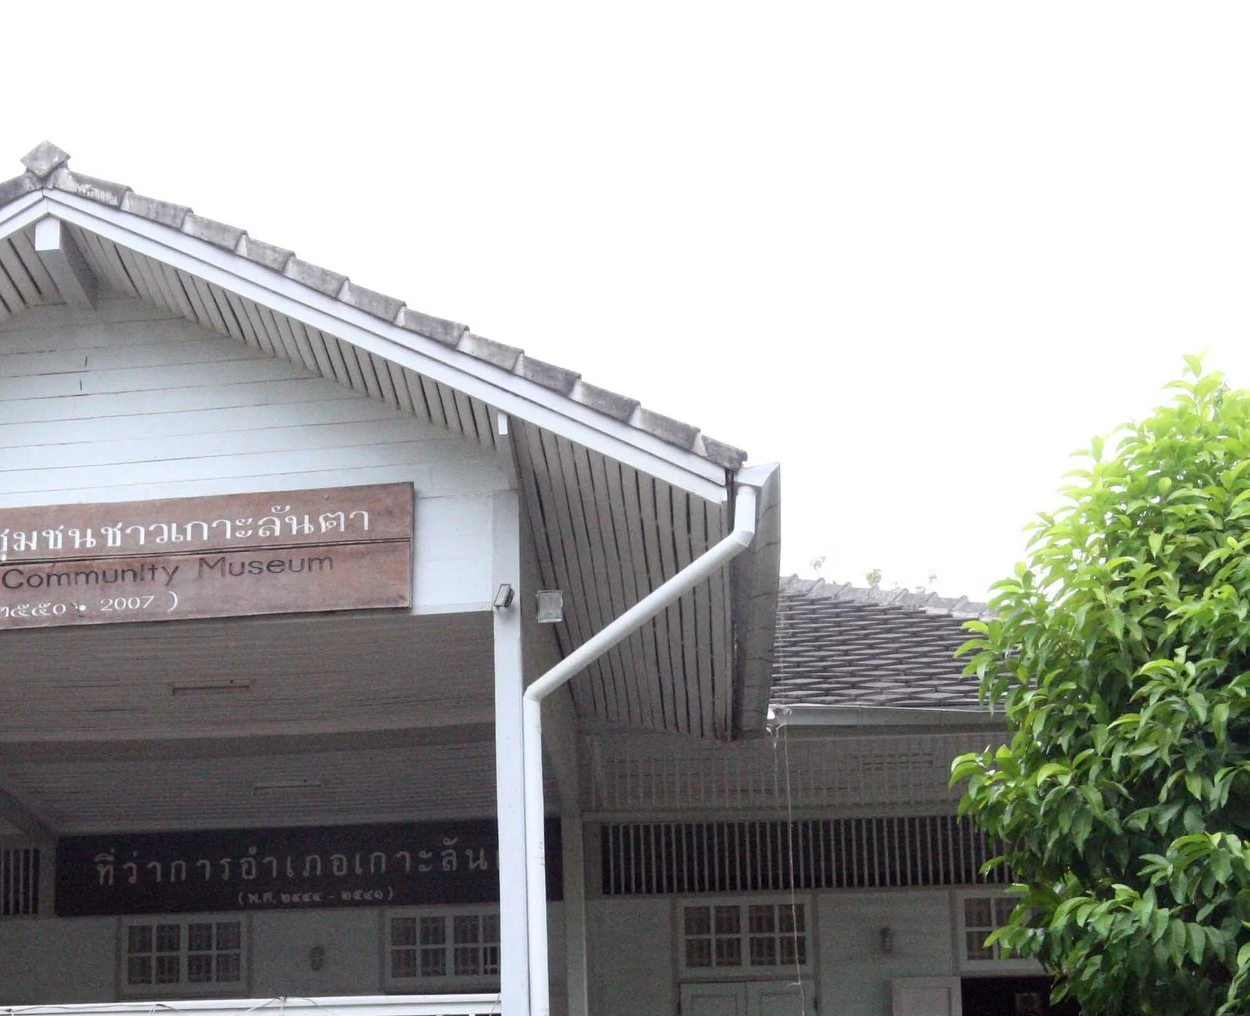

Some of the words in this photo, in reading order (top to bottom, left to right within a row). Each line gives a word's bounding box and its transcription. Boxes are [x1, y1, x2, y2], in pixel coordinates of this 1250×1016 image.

[1, 562, 180, 591] Community
[198, 555, 334, 580] Museum
[94, 836, 498, 886] ที่ว่าการอำเภอเกาะลัน
